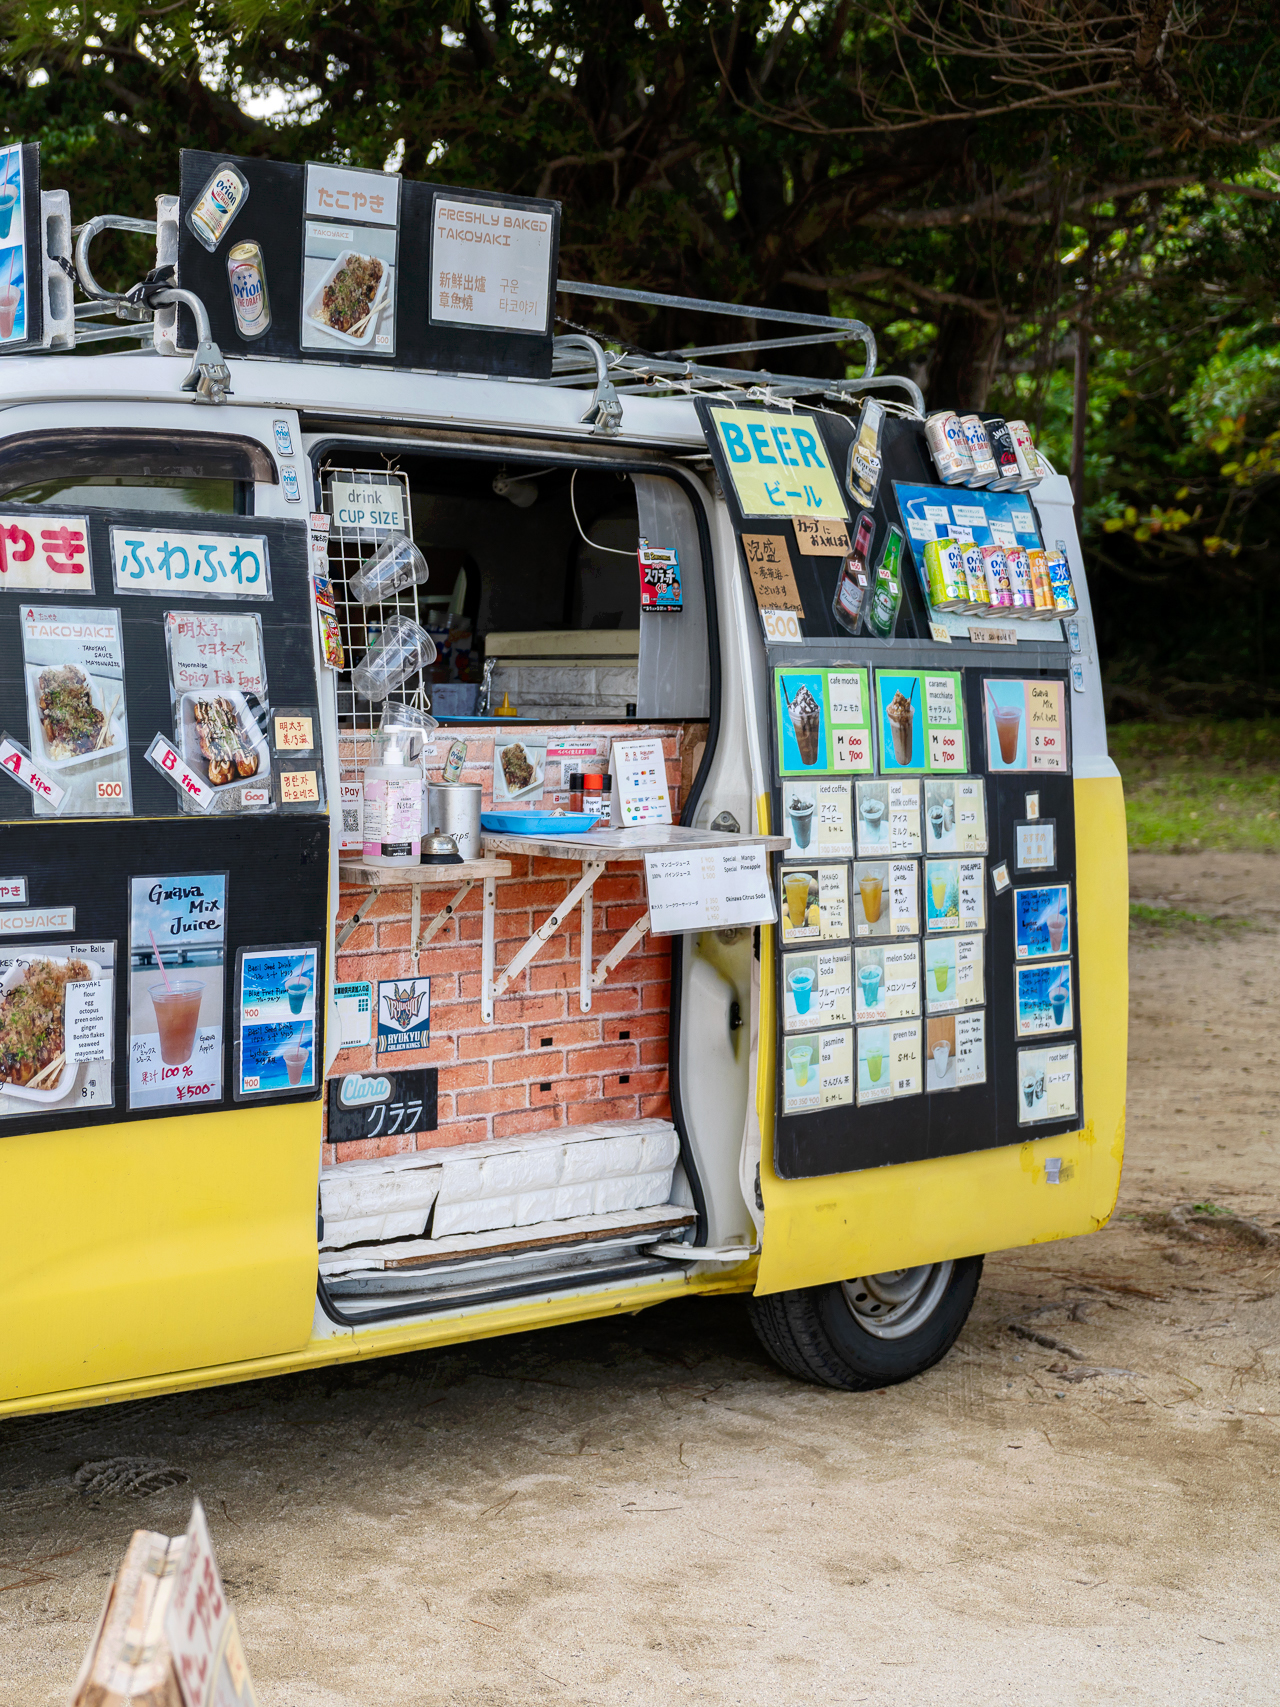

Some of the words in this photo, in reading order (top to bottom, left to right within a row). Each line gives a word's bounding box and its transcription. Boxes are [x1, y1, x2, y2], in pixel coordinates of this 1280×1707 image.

[216, 179, 237, 207] Orion
[318, 187, 385, 214] たこやき
[438, 207, 500, 226] FRESHLY
[503, 216, 548, 232] BAKED
[313, 228, 349, 239] TAKOYAKI
[437, 226, 511, 247] TAKOYAKI
[439, 271, 487, 293] 新鮮出爐
[499, 278, 519, 294] 구운
[233, 279, 263, 299] Orion
[439, 291, 474, 312] 章魚燒
[499, 297, 538, 316] 타코야키
[376, 336, 390, 344] 500
[720, 421, 826, 468] BEER
[1003, 466, 1018, 474] 400
[347, 489, 383, 505] drink
[763, 480, 822, 508] ビール
[338, 508, 365, 525] CUP
[370, 510, 399, 526] SIZE
[120, 539, 261, 584] ふわふわ
[644, 567, 676, 584] スクラッチ
[655, 583, 668, 594] くじ
[25, 609, 36, 622] A
[27, 625, 114, 638] TAKOYAKI
[178, 621, 222, 638] 明太子
[764, 615, 798, 637] 500
[933, 627, 948, 639] 350
[197, 640, 246, 658] マヨネーズ
[179, 670, 209, 687] Spicy
[214, 669, 235, 684] Fish
[237, 670, 260, 688] Eggs
[830, 677, 840, 685] cafe
[842, 677, 858, 685] mocha
[929, 692, 954, 700] macchiato
[1032, 688, 1049, 698] Guava
[928, 705, 952, 713] キャラメル
[928, 715, 952, 723] マキアート
[838, 736, 844, 744] M
[848, 736, 862, 746] 600
[942, 736, 956, 746] 600
[1035, 736, 1040, 746] S
[1044, 736, 1056, 746] 500
[840, 751, 846, 761] L
[848, 750, 864, 762] 700
[933, 753, 939, 762] L
[942, 751, 955, 763] 700
[2, 752, 22, 775] A
[30, 773, 52, 796] tipe
[161, 749, 178, 771] B
[181, 774, 202, 796] tipe
[97, 783, 122, 798] 500
[344, 786, 360, 798] Pay
[820, 785, 831, 794] iced
[832, 784, 848, 793] coffee
[890, 786, 901, 794] iced
[244, 790, 265, 802] 600
[902, 798, 918, 806] coffee
[821, 805, 838, 813] アイス
[961, 813, 976, 821] コーラ
[892, 828, 908, 836] ミルク
[892, 864, 914, 872] ORANGE
[148, 883, 204, 905] Guava
[170, 916, 222, 935] Juice
[90, 945, 106, 954] Balls
[820, 956, 832, 966] blue
[832, 954, 851, 963] hawaii
[886, 955, 903, 963] melon
[903, 952, 916, 960] Soda
[820, 967, 834, 976] Soda
[819, 986, 851, 998] ブルーハワイ
[886, 981, 918, 992] メロンソーダ
[819, 1000, 836, 1009] ソーダ
[79, 1007, 99, 1015] octopus
[244, 1009, 259, 1018] 400
[856, 1012, 866, 1020] 300
[74, 1016, 88, 1025] green
[81, 1024, 97, 1032] ginger
[388, 1030, 420, 1044] RYUKYU
[892, 1031, 908, 1042] green
[78, 1040, 100, 1048] seaweed
[822, 1036, 844, 1050] jasmine
[74, 1049, 104, 1057] mayonnaise
[1048, 1054, 1058, 1062] root
[244, 1078, 259, 1088] 400
[344, 1079, 388, 1101] Clara
[367, 1100, 423, 1138] クララ
